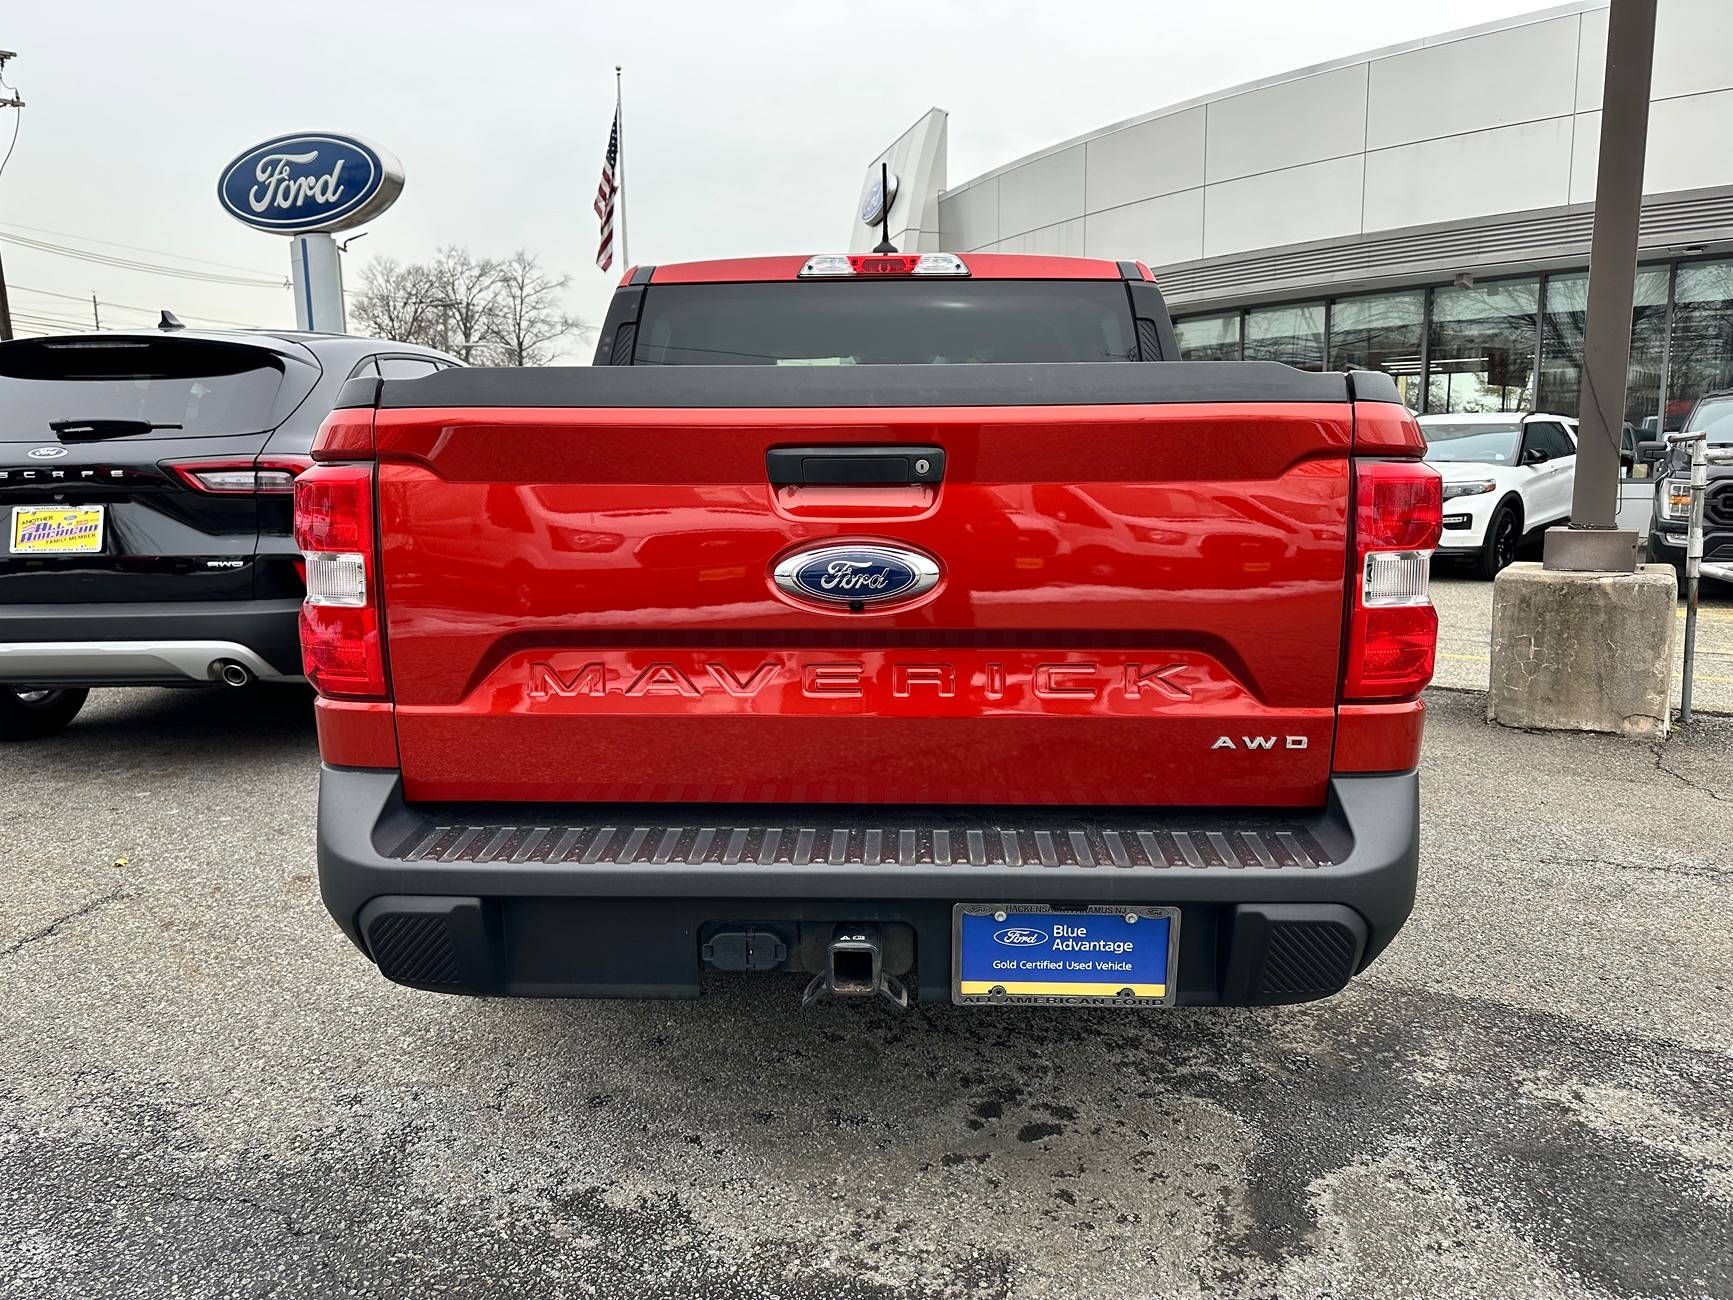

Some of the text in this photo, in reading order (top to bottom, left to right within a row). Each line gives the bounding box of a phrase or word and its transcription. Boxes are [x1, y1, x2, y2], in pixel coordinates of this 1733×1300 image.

[249, 151, 345, 212] Ford
[21, 515, 54, 526] ANOTHER
[45, 533, 97, 545] FAMILY MEMBER
[820, 560, 890, 589] Ford
[528, 662, 1193, 699] MAVERICK
[1211, 735, 1309, 750] AWD
[1004, 929, 1038, 943] Ford
[1053, 925, 1087, 937] Blue
[1052, 939, 1134, 954] Advantage
[992, 960, 1133, 971] Gold Certified Used Vehicle
[963, 996, 1165, 1006] ALL AMERICAN FORD
